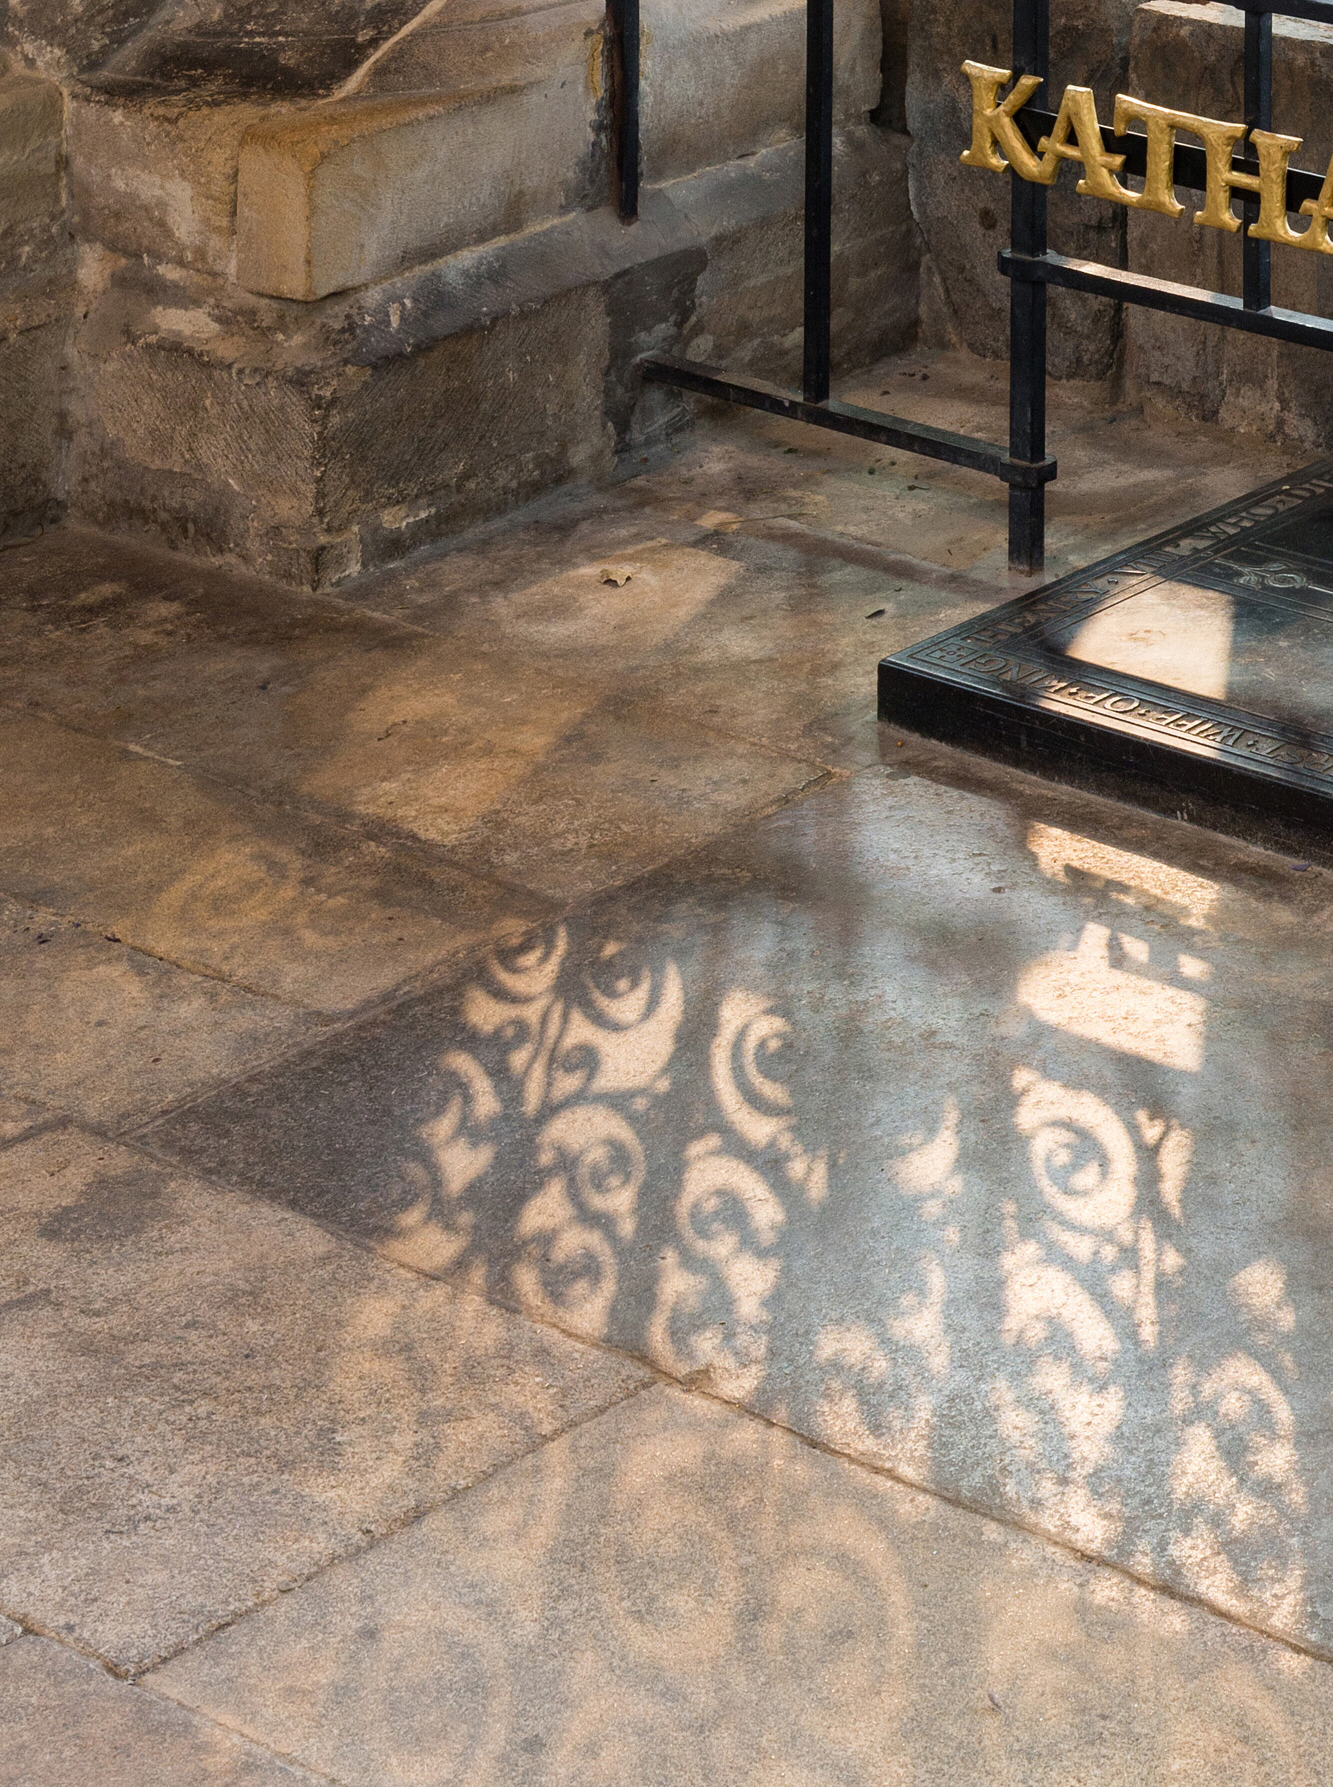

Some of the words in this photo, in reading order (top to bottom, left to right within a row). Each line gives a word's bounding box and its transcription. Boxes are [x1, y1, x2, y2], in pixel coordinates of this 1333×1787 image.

[965, 578, 1120, 644] HENRY
[1185, 502, 1287, 544] WHO
[962, 654, 1079, 693] KING
[1069, 685, 1151, 714] OF
[1144, 707, 1254, 745] WIFE
